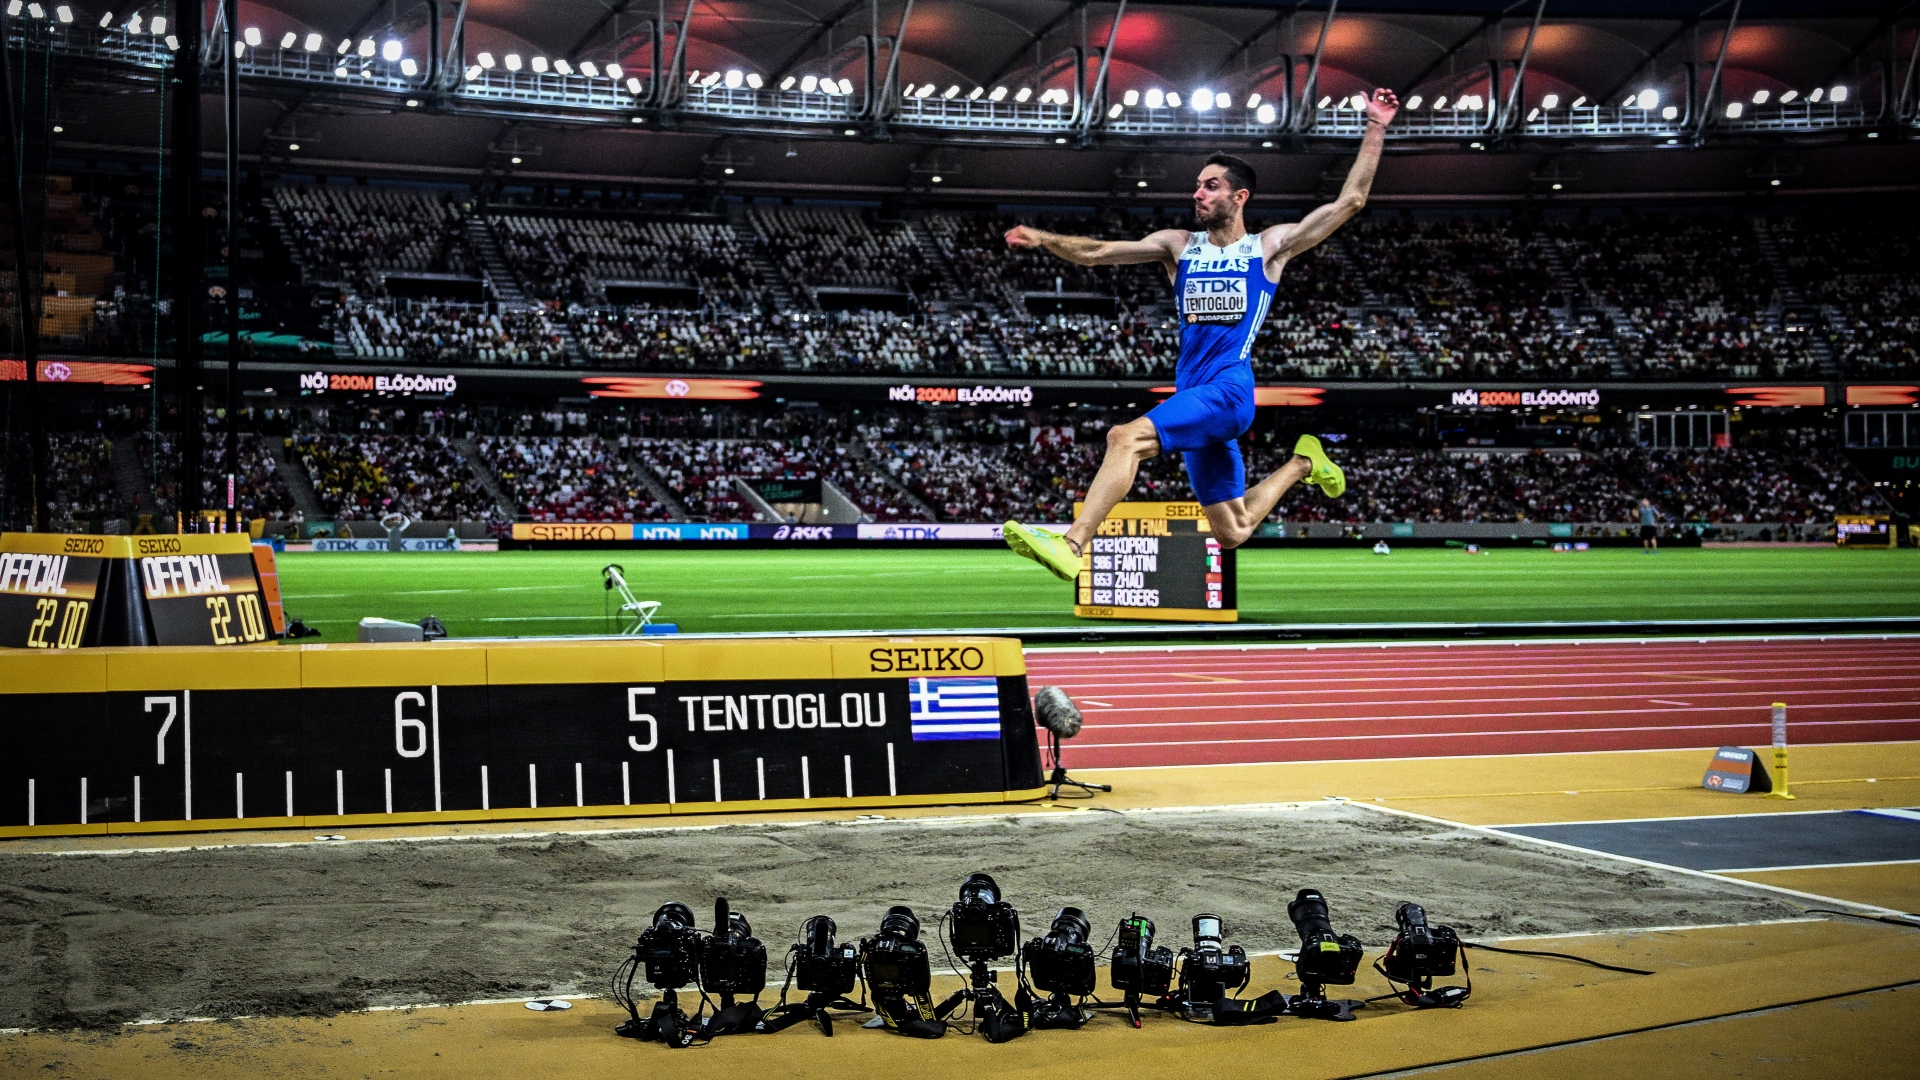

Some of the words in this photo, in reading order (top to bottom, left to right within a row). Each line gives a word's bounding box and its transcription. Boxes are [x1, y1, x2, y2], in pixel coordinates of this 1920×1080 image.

[1186, 259, 1249, 274] HELLAS
[1196, 280, 1241, 292] TDK
[1185, 296, 1243, 311] TENTOGLOU
[330, 374, 373, 390] 200M
[916, 387, 956, 401] 200M
[1479, 391, 1520, 405] 200M
[1165, 505, 1204, 516] SEIK
[531, 526, 615, 540] SEIKO
[642, 527, 680, 539] NTN
[700, 527, 737, 539] NTN
[899, 527, 940, 539] TDK
[1140, 519, 1171, 535] FINAL
[64, 538, 103, 553] SEIKO
[138, 538, 181, 553] SEIKO
[326, 540, 358, 549] TDK
[376, 540, 407, 549] TK
[424, 540, 455, 549] TDK
[1114, 537, 1158, 554] KOPRON
[1114, 554, 1156, 571] FANTINI
[0, 552, 69, 595] OFFICIAL
[140, 553, 231, 597] OFFICIAL
[1114, 571, 1143, 588] ZHAO
[1114, 589, 1159, 606] ROGERS
[27, 598, 89, 650] 22.00
[206, 594, 266, 646] 22.00
[869, 646, 985, 673] SEIKO
[394, 691, 427, 758] 6
[627, 686, 658, 752] 5
[678, 692, 887, 732] TENTOGLOU
[144, 696, 177, 765] 7
